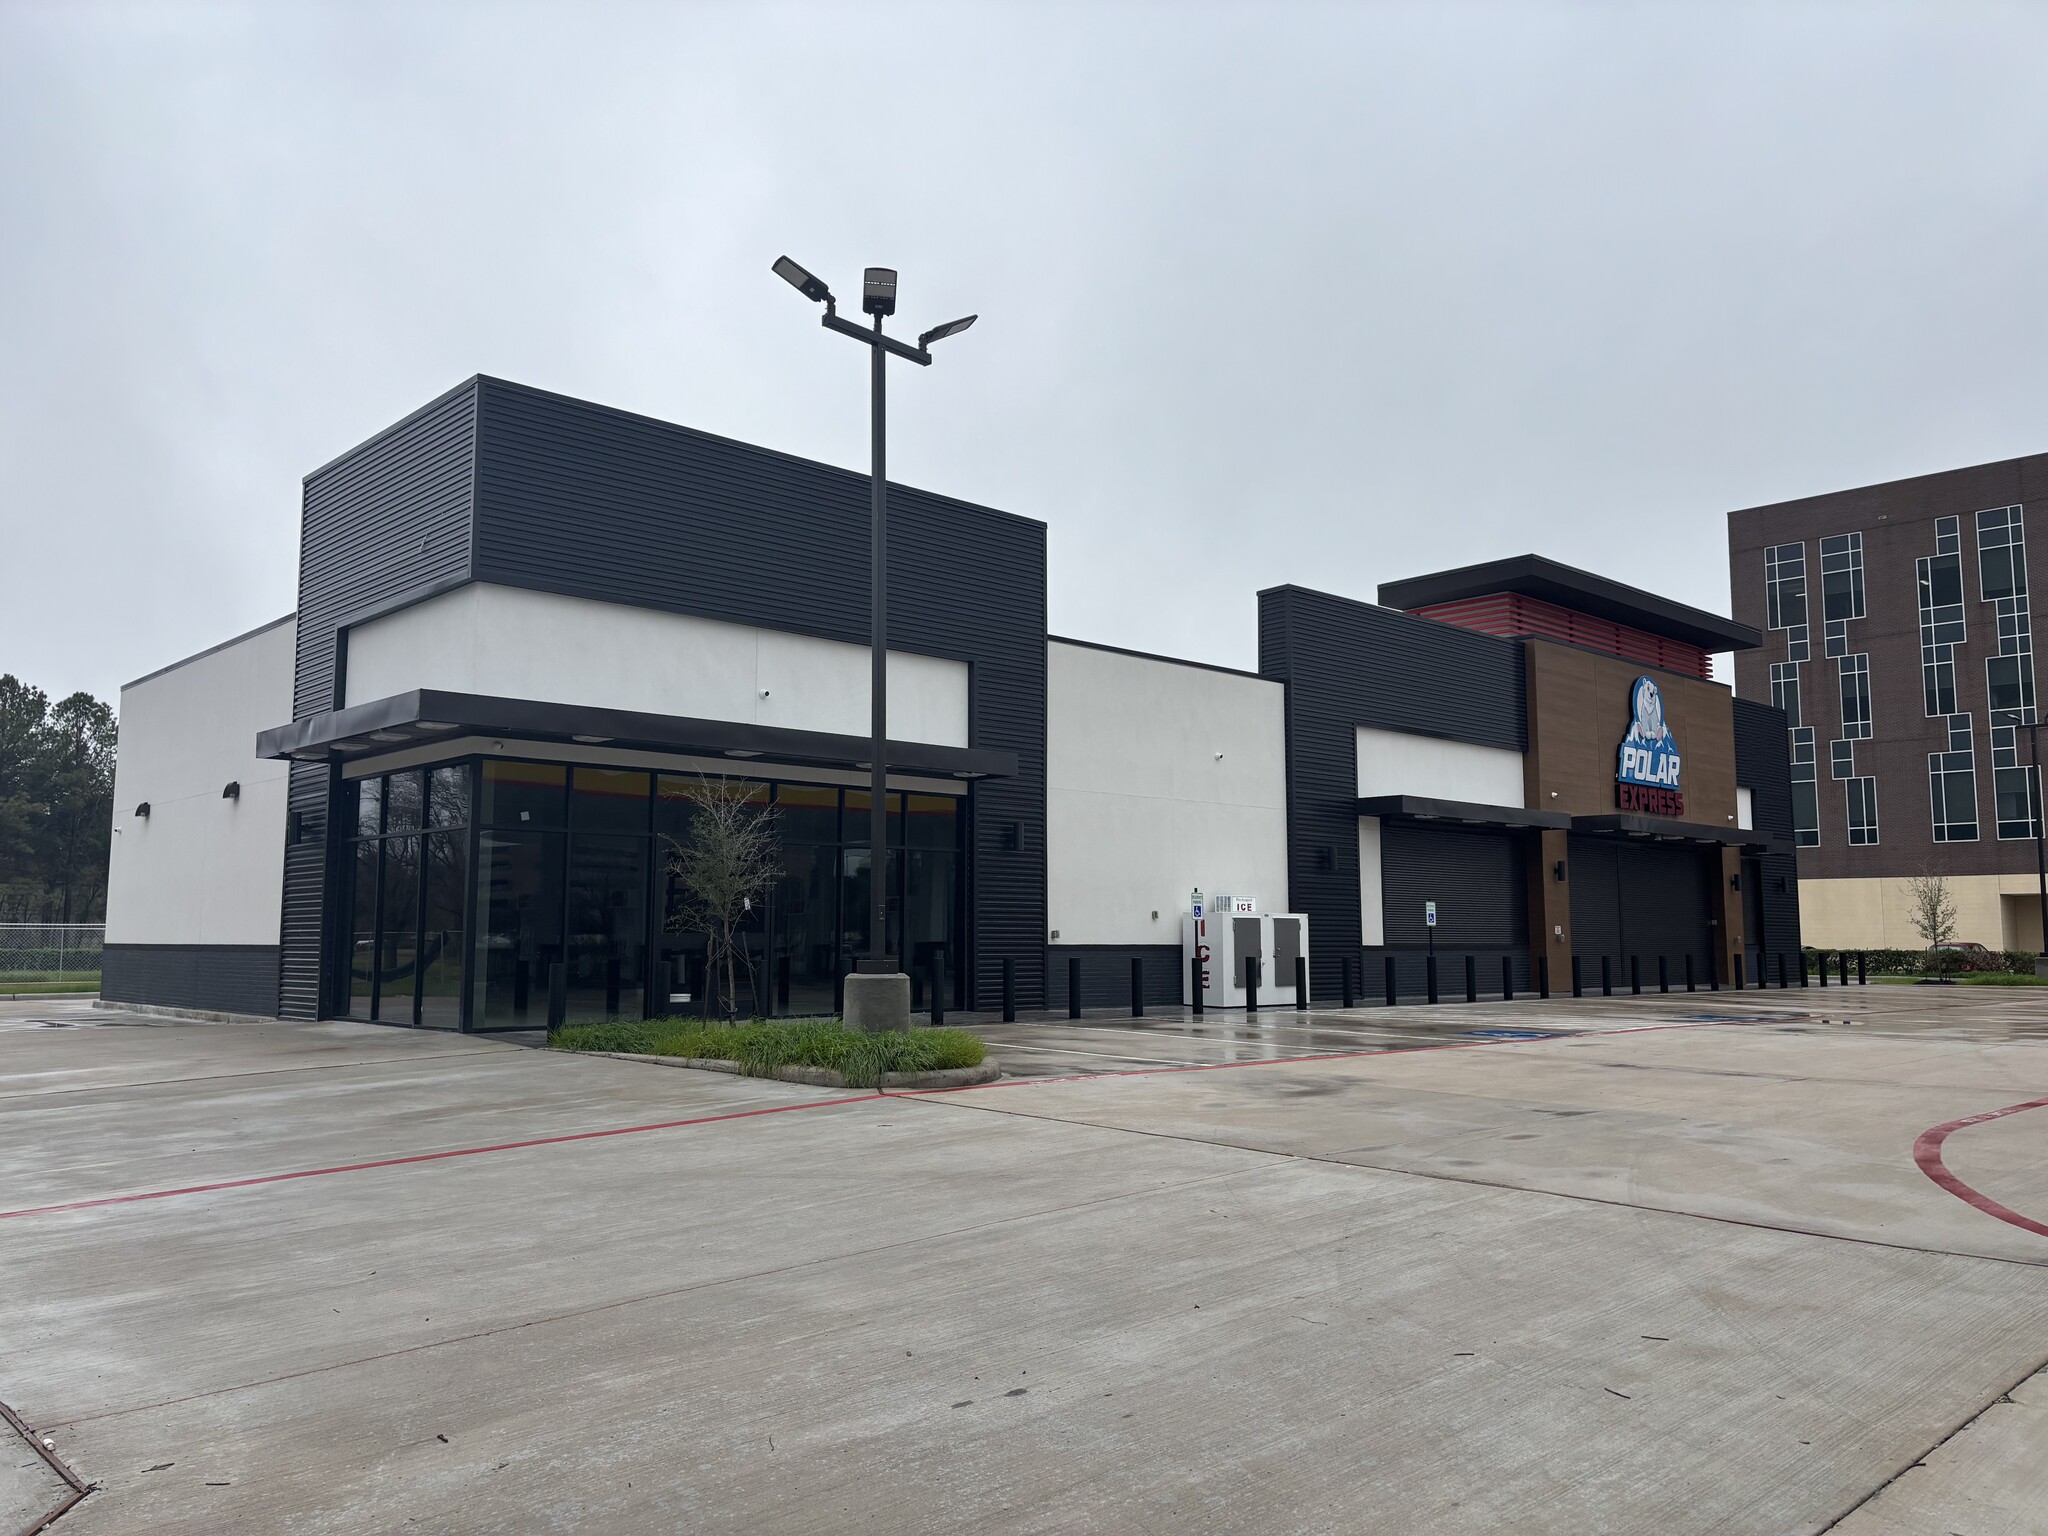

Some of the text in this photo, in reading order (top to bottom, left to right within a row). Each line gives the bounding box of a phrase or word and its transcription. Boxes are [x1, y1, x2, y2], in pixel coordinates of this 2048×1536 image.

[1621, 746, 1681, 785] POLAR
[1620, 784, 1684, 816] EXPRESS
[1236, 903, 1252, 911] ICE
